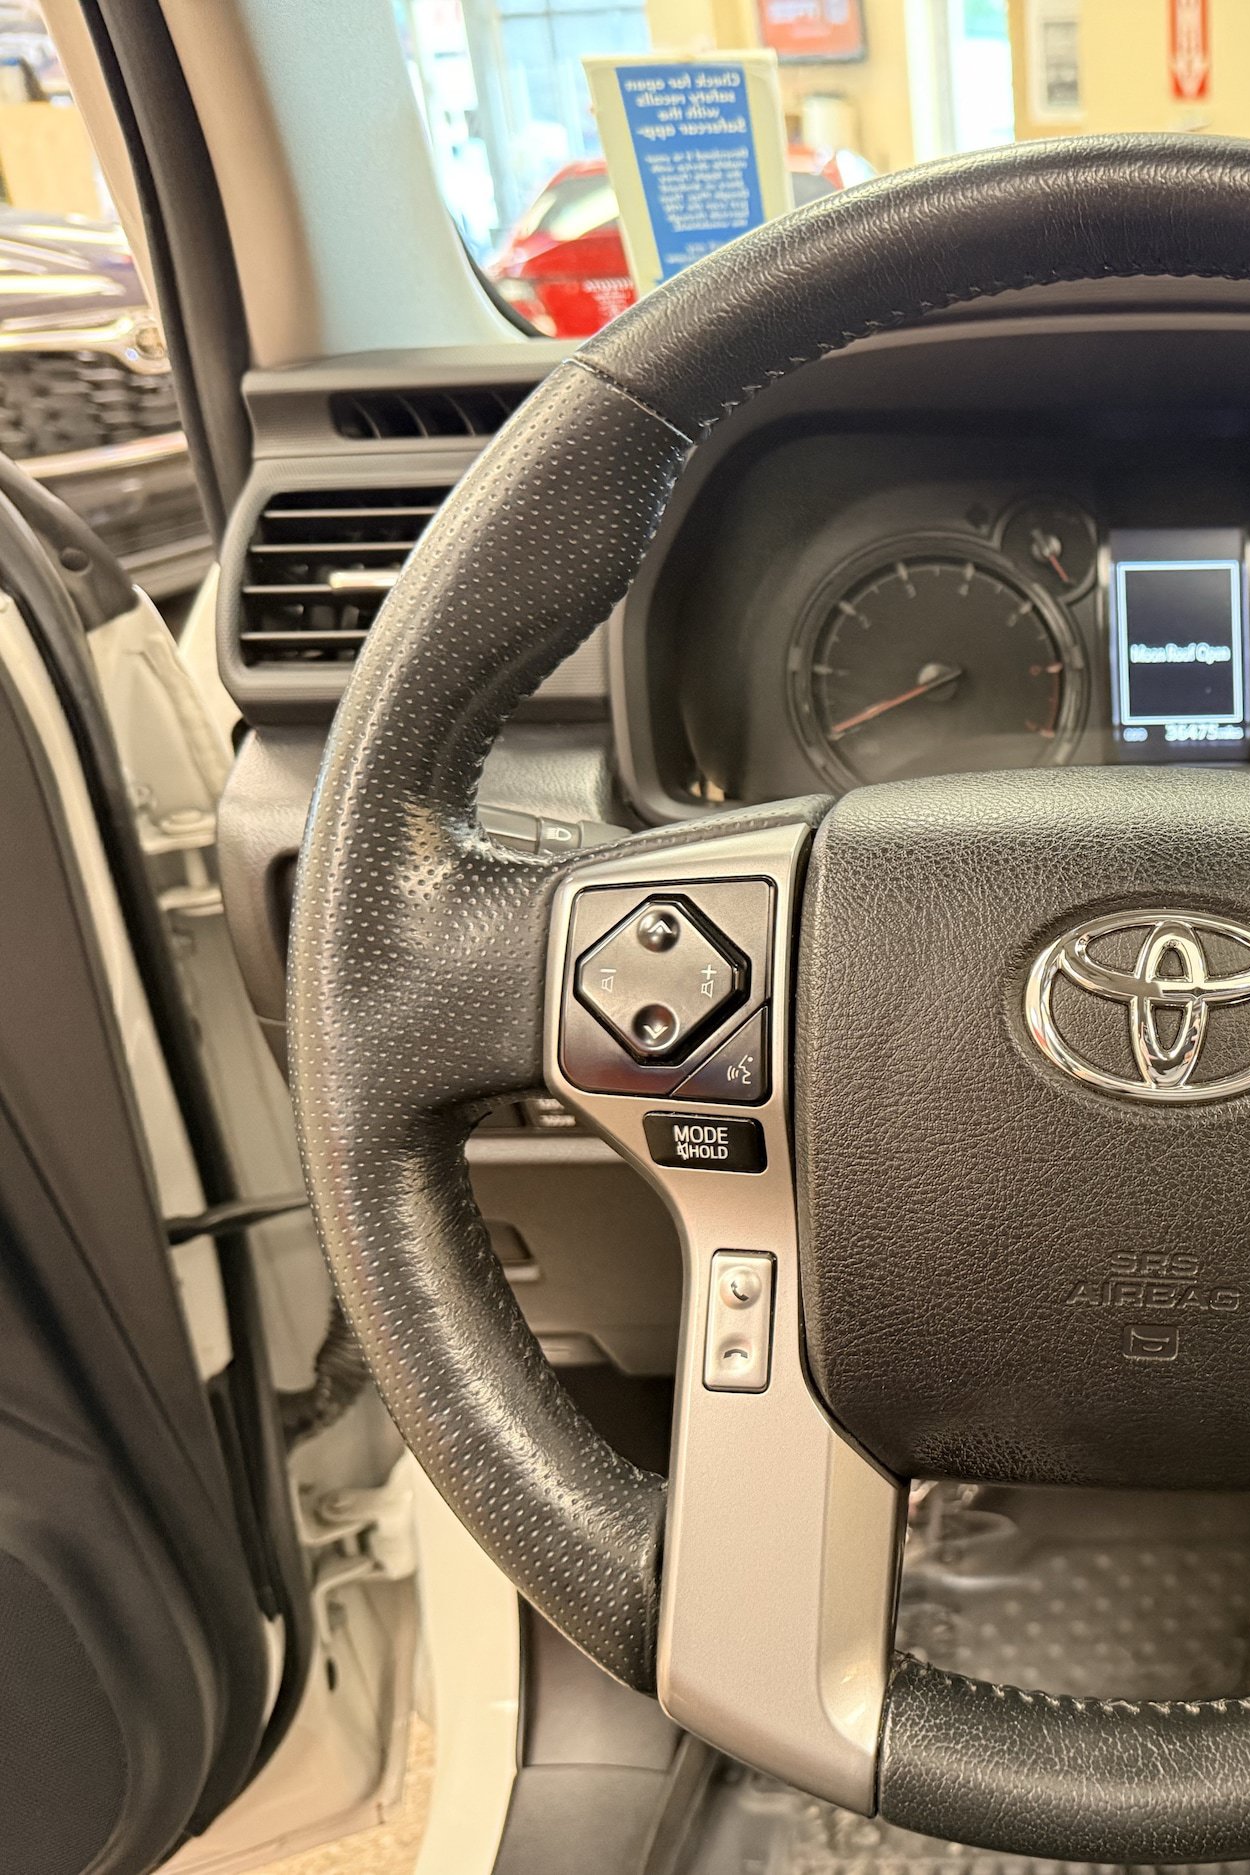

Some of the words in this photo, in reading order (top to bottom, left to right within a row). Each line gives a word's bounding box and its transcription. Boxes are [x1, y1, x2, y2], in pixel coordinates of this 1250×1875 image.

[673, 1124, 729, 1144] MODE
[689, 1144, 729, 1160] HOLD
[1109, 1251, 1199, 1275] SRS
[1066, 1281, 1241, 1312] AIRBAG
